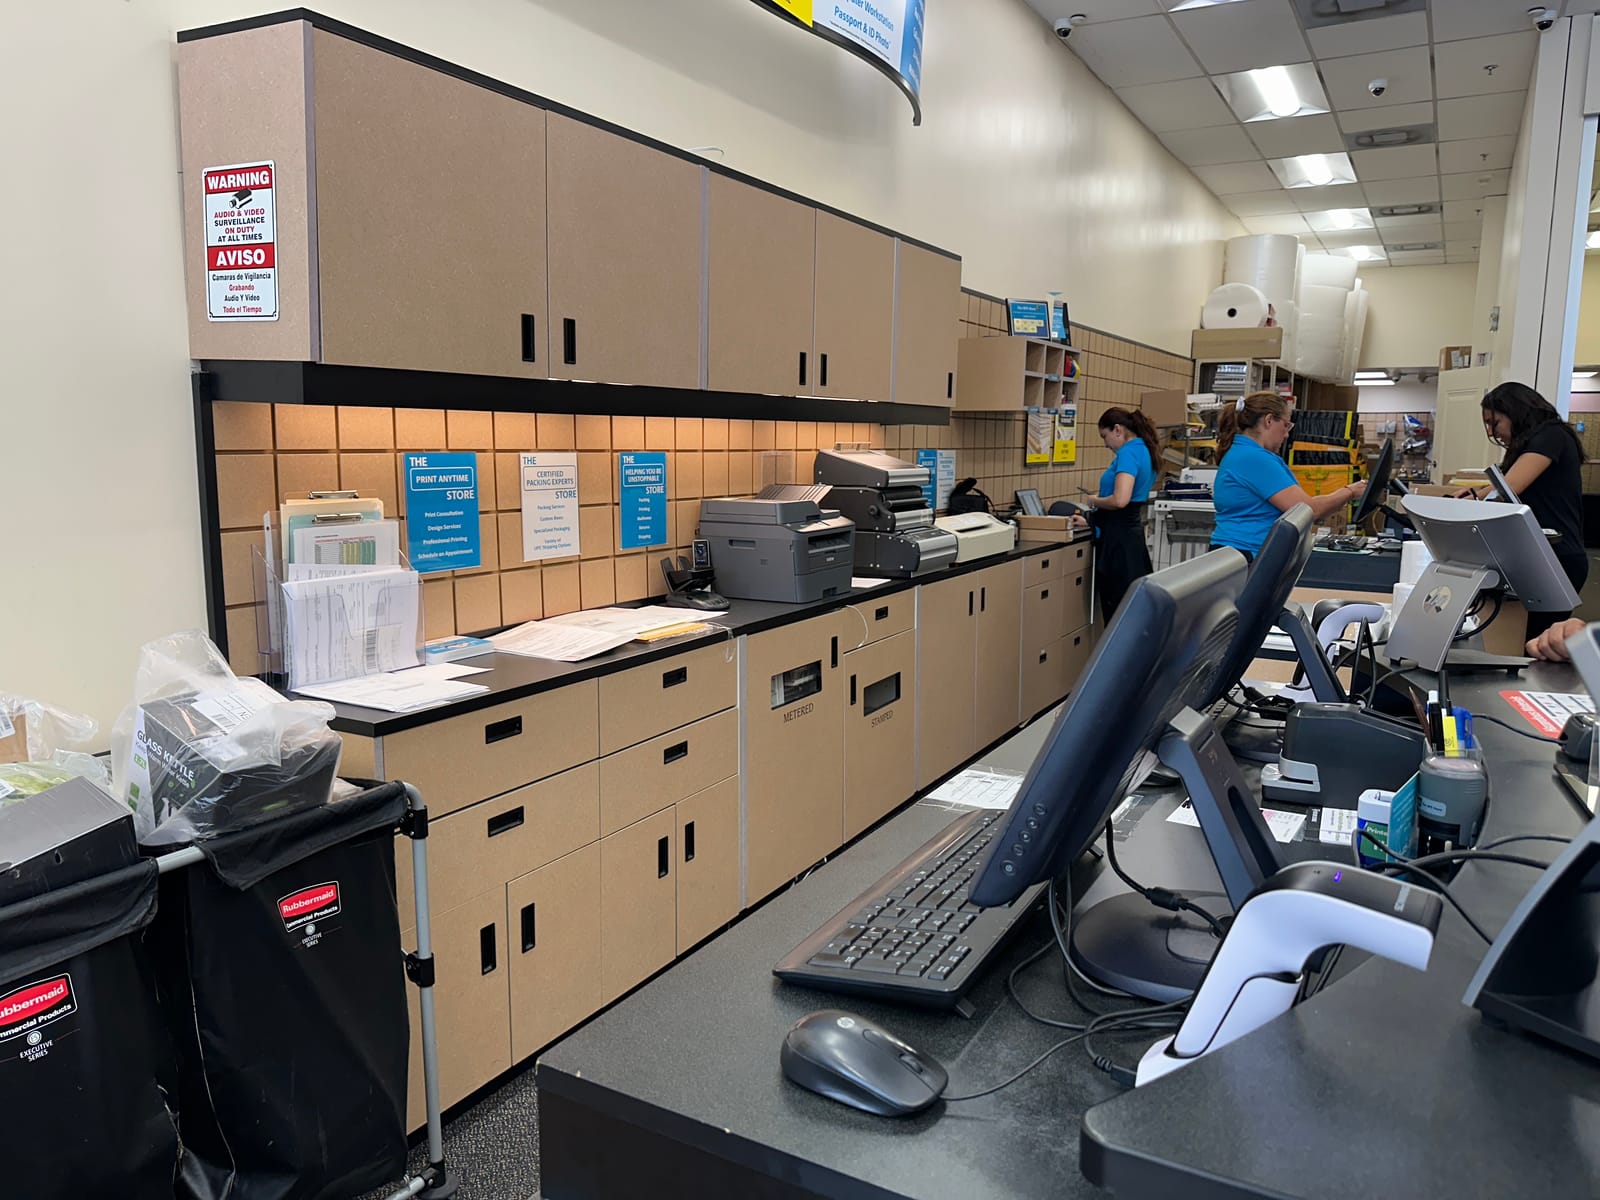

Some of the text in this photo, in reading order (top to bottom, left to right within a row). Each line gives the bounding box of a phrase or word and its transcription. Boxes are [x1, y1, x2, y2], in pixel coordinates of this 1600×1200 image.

[864, 0, 894, 31] Workstation
[834, 5, 890, 50] Passport & ID Photo
[207, 171, 270, 190] WARNING
[214, 208, 265, 218] AUDIO & VIDEO
[214, 216, 265, 227] SURVEILLANCE
[241, 233, 263, 241] TIMES
[216, 248, 266, 267] AVISO
[212, 273, 236, 281] Camaras
[244, 272, 271, 282] Vigilancia
[224, 294, 239, 302] Audio
[245, 293, 260, 301] Video
[243, 306, 262, 314] Tiempo
[409, 456, 428, 467] THE
[522, 456, 537, 465] THE
[622, 455, 635, 464] THE
[416, 474, 469, 484] PRINT ANYTIME
[536, 470, 564, 478] CERTIFIED
[628, 475, 660, 483] UNSTOPPABLE
[526, 478, 574, 487] PACKING EXPERTS
[446, 489, 475, 501] STORE
[555, 489, 577, 499] STORE
[645, 485, 665, 495] STORE
[783, 702, 814, 724] METERED
[871, 710, 894, 728] STAMPED
[137, 730, 163, 755] GLASS
[282, 889, 334, 913] Rubbermaid
[314, 905, 338, 918] Products
[0, 983, 65, 1019] ubbermaid
[0, 1003, 72, 1038] mmercial Products
[19, 1039, 54, 1059] EXECUTIVE
[27, 1048, 49, 1062] SERIES
